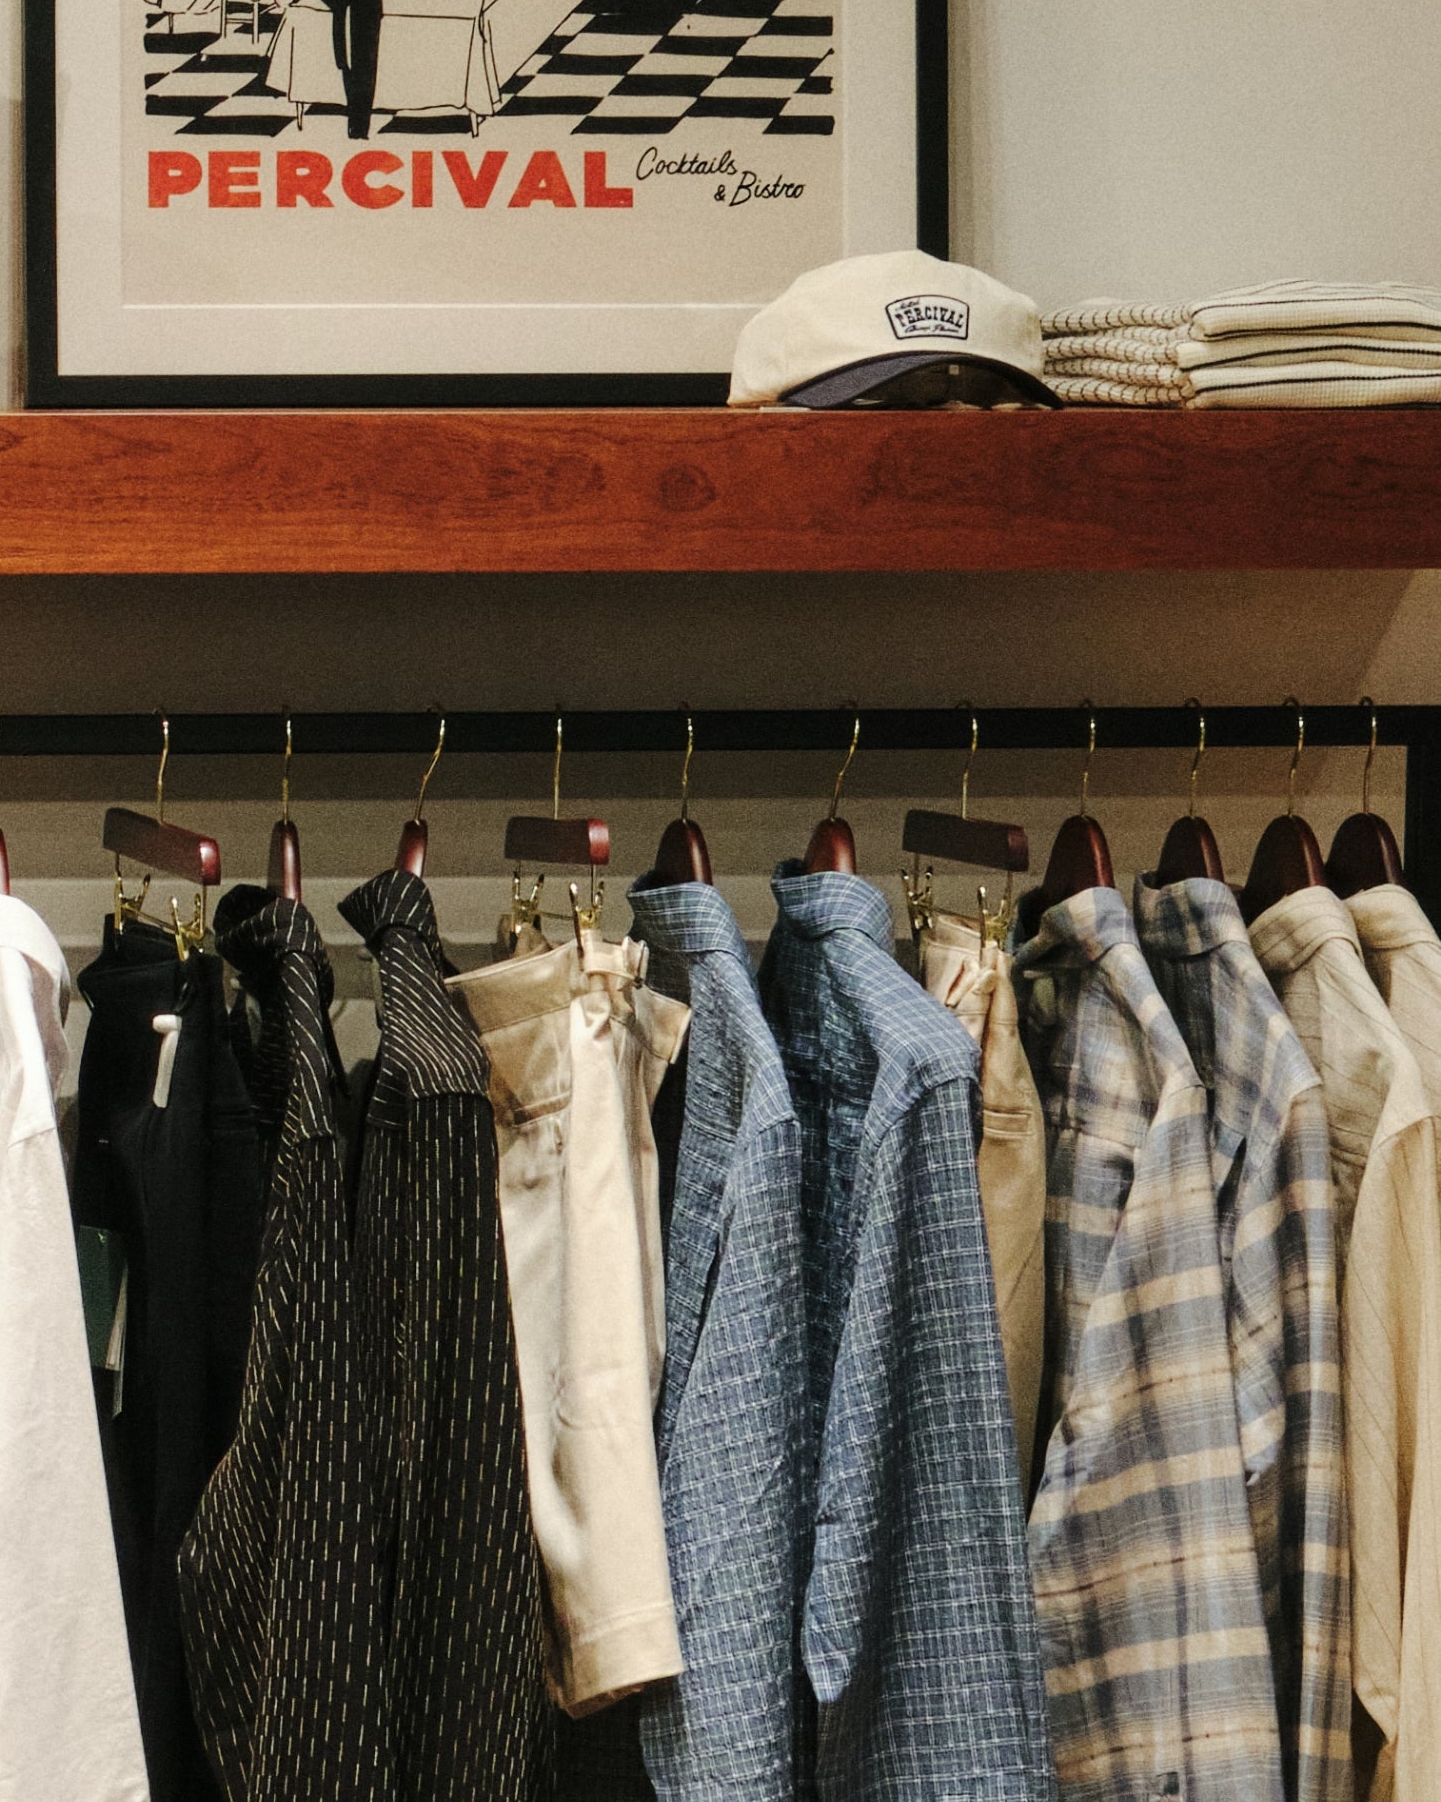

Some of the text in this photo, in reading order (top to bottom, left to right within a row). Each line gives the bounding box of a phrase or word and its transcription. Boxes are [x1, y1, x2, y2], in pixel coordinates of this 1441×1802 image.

[148, 149, 634, 209] PERCIVAL
[636, 146, 738, 181] Cocktails
[714, 171, 807, 207] & Bistro
[894, 306, 964, 329] PERCIVAL
